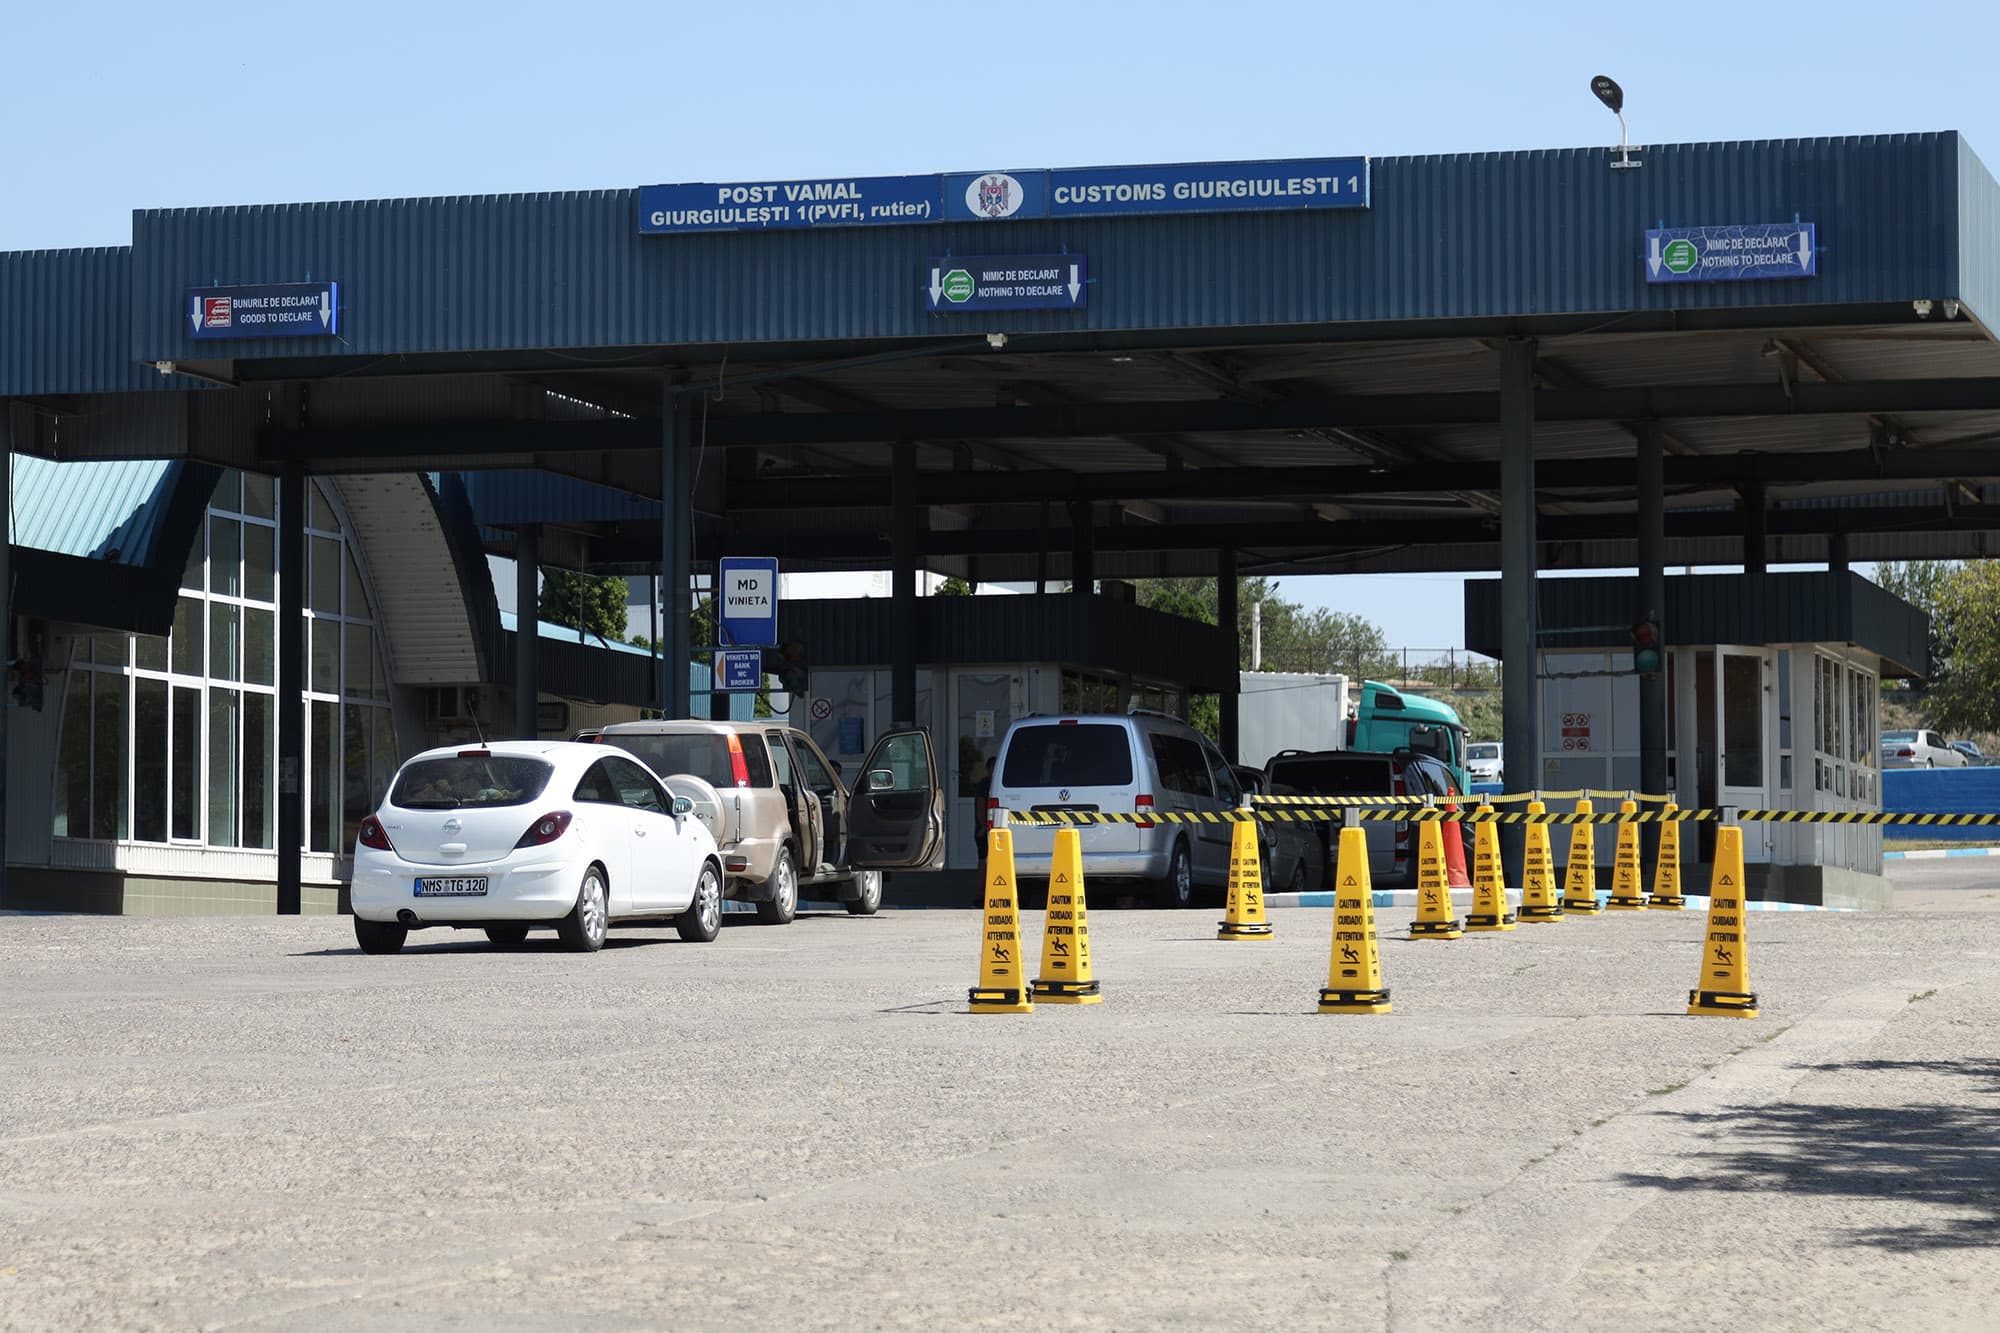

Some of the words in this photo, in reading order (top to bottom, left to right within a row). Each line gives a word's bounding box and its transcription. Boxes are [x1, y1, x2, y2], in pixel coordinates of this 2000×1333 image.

[718, 185, 777, 205] POST
[784, 182, 862, 203] VAMAL
[1054, 182, 1166, 204] CUSTOMS
[1173, 177, 1339, 199] GIURGIULESTI
[1348, 176, 1358, 193] 1
[871, 200, 931, 218] rutier)
[1707, 239, 1730, 250] NIMIC
[1731, 238, 1743, 249] DE
[1745, 237, 1788, 249] DECLARAT
[1702, 256, 1739, 267] NOTHING
[1741, 255, 1753, 265] TO
[1754, 253, 1793, 265] DECLARE
[983, 271, 1004, 281] NIMIC
[1006, 271, 1017, 281] DE
[1018, 269, 1059, 281] DECLARAT
[978, 287, 1013, 297] NOTHING
[1015, 287, 1025, 296] TO
[1026, 286, 1063, 296] DECLARE
[233, 297, 268, 308] BUNURILE
[270, 297, 280, 307] DE
[281, 296, 319, 306] DECLARAT
[240, 313, 266, 323] GOODS
[268, 313, 278, 322] TO
[279, 312, 312, 322] DECLARE
[737, 579, 758, 590] MD
[728, 596, 768, 606] VINIETA
[422, 879, 442, 892] NMS
[450, 879, 463, 892] TG
[465, 879, 485, 892] 120
[989, 898, 1011, 908] CAUTION
[1051, 895, 1072, 905] CAUTION
[1339, 899, 1361, 909] CAUTION
[1713, 898, 1737, 909] CAUTION
[1337, 915, 1363, 925] CUIDADO
[1712, 916, 1738, 926] CUIDADO
[987, 931, 1014, 941] ATTENTION
[1047, 926, 1074, 935] ATTENTION
[1336, 931, 1364, 941] ATTENTION
[1710, 932, 1739, 942] ATTENTION
